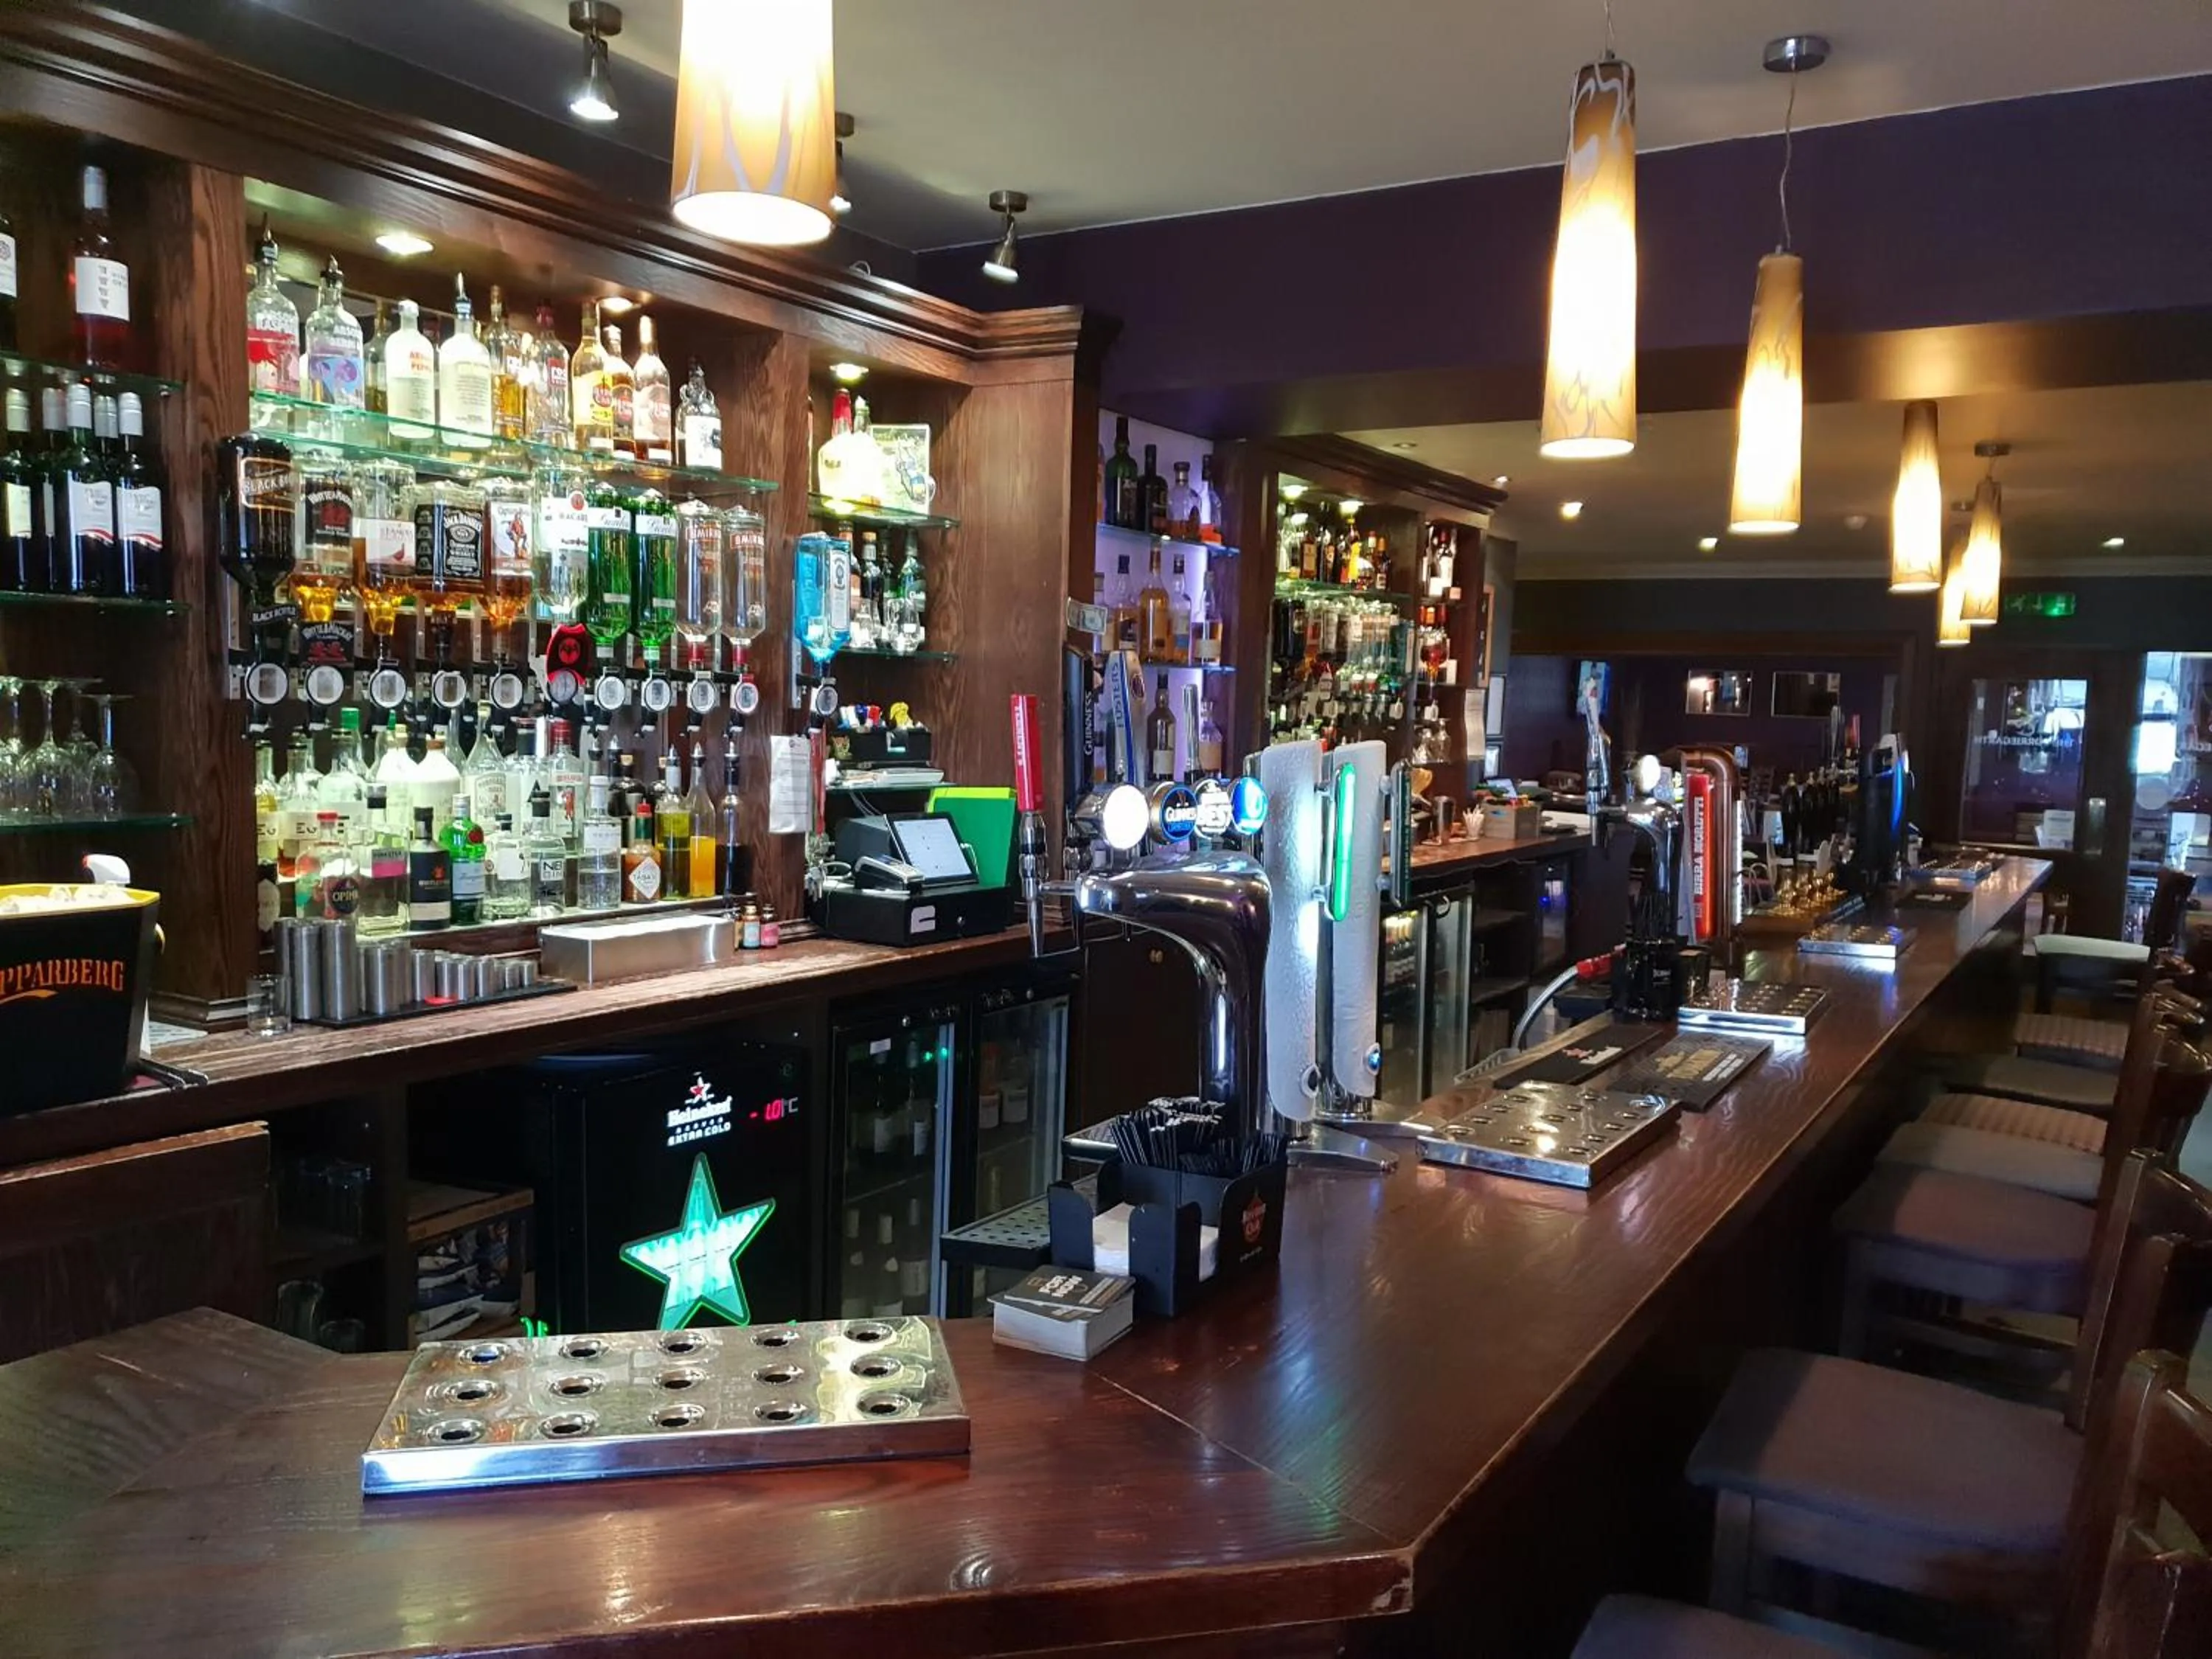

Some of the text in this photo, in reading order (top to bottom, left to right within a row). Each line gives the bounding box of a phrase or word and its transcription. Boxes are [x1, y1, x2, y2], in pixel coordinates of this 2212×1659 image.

[690, 526, 721, 539] SMIRN
[735, 534, 764, 546] SMIRN
[1084, 690, 1093, 756] GUINNESS
[668, 1098, 731, 1127] Heineken
[667, 1121, 731, 1146] EXTRA COLD
